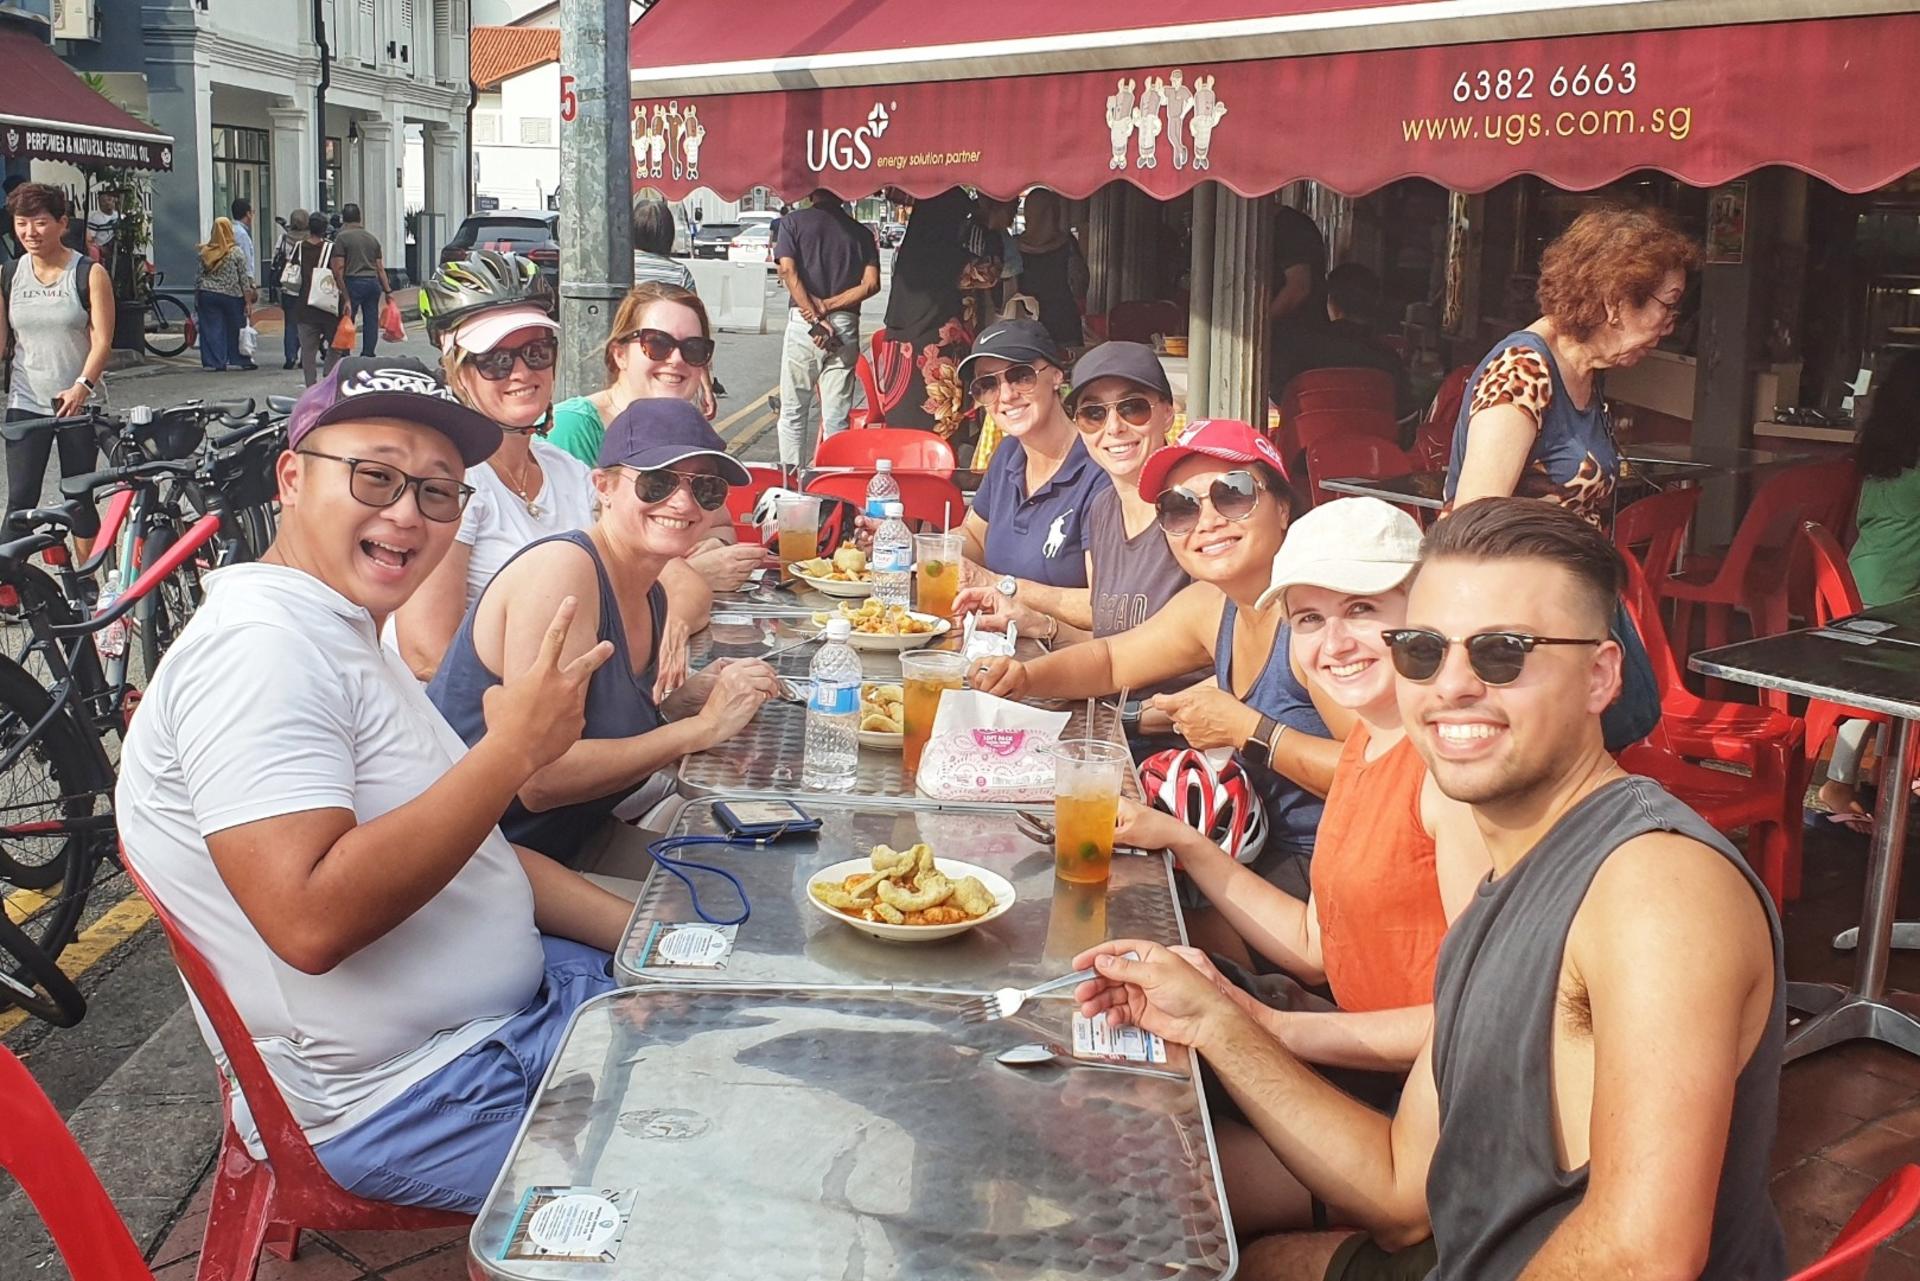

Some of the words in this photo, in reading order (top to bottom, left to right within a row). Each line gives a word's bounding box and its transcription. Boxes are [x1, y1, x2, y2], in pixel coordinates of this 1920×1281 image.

[561, 76, 576, 122] 5
[1453, 67, 1535, 102] 6382
[1549, 62, 1637, 97] 6663
[1402, 107, 1691, 145] www.ugs.com.sg
[26, 132, 65, 153] PERFUMES
[66, 136, 73, 154] &
[73, 137, 105, 158] NATURAL
[106, 141, 138, 161] ESSENTIAL
[139, 145, 150, 162] OIL
[807, 126, 872, 172] UGS
[877, 154, 907, 169] energy
[909, 152, 944, 166] solution
[945, 150, 981, 166] partner
